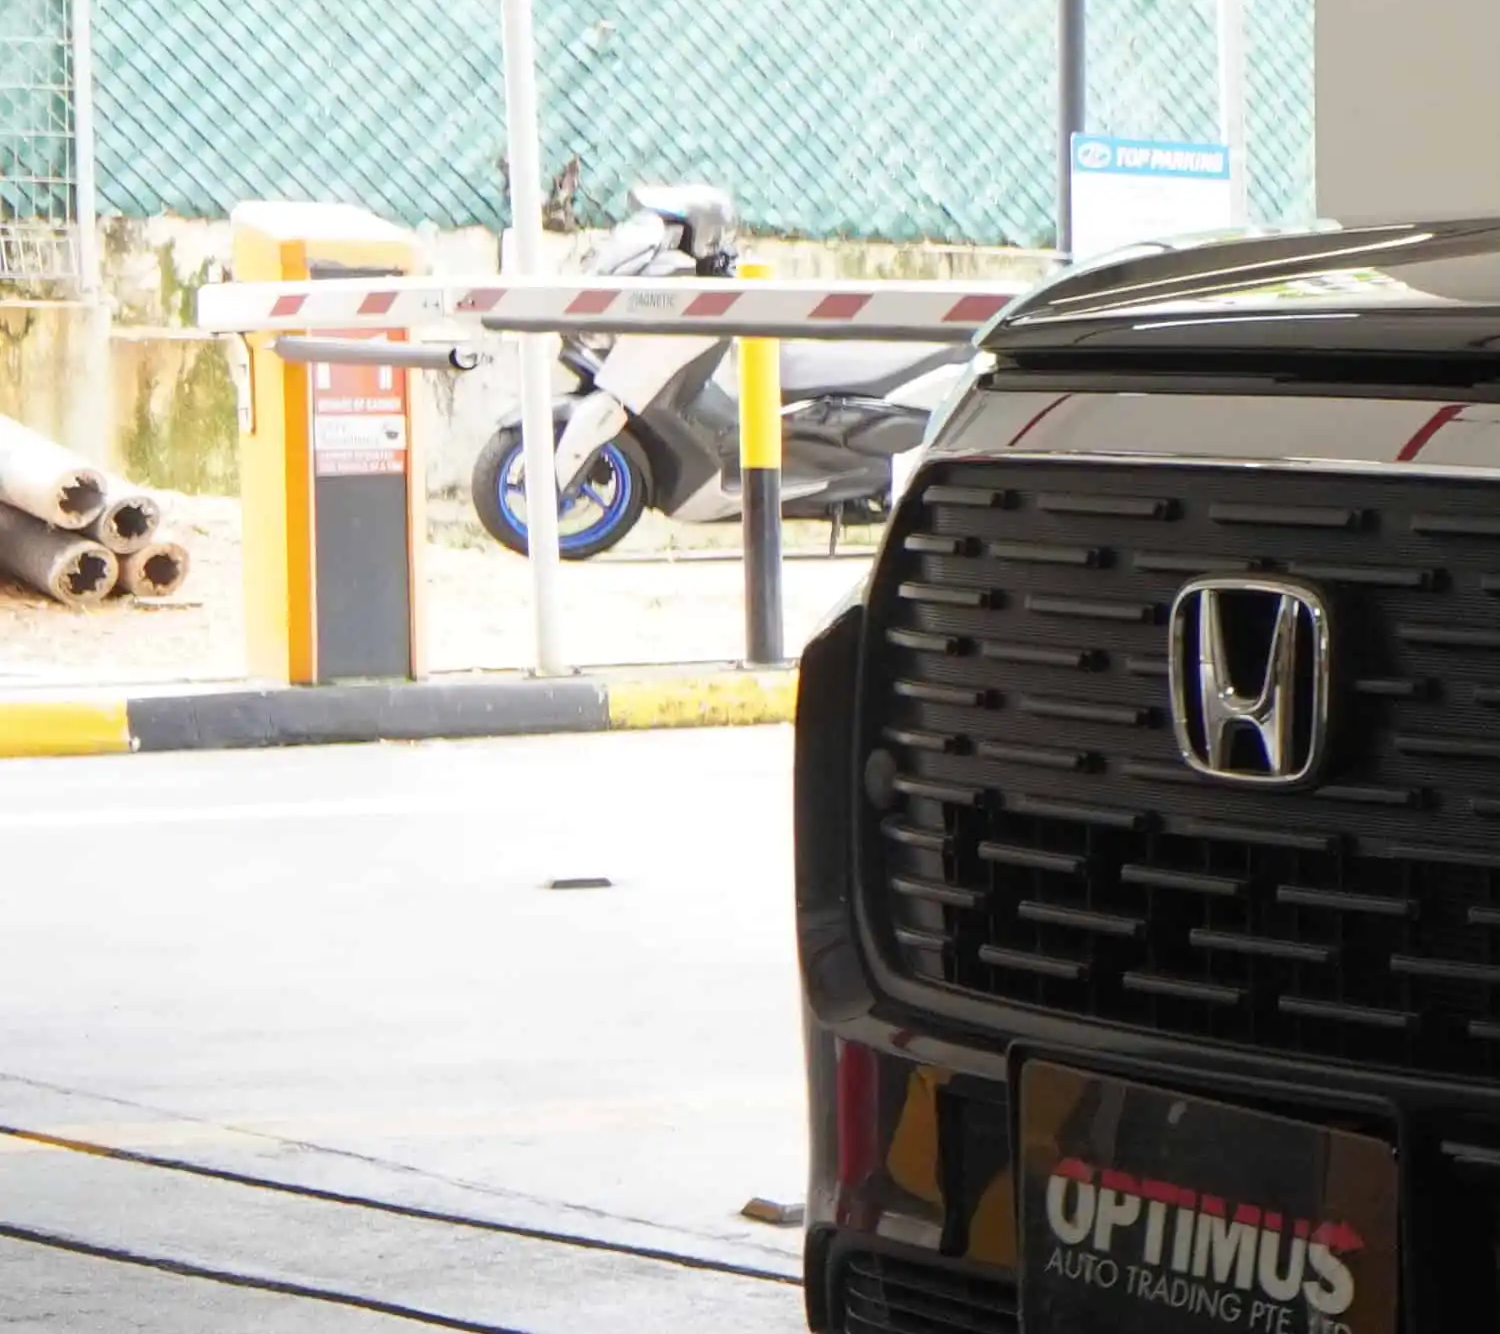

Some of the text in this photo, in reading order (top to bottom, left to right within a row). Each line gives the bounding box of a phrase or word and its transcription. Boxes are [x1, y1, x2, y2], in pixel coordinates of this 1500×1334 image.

[1116, 146, 1224, 173] TOP PARKING
[1045, 1156, 1364, 1317] OPTIMUS
[1045, 1246, 1119, 1289] AUTO
[1126, 1264, 1242, 1323] TRADING
